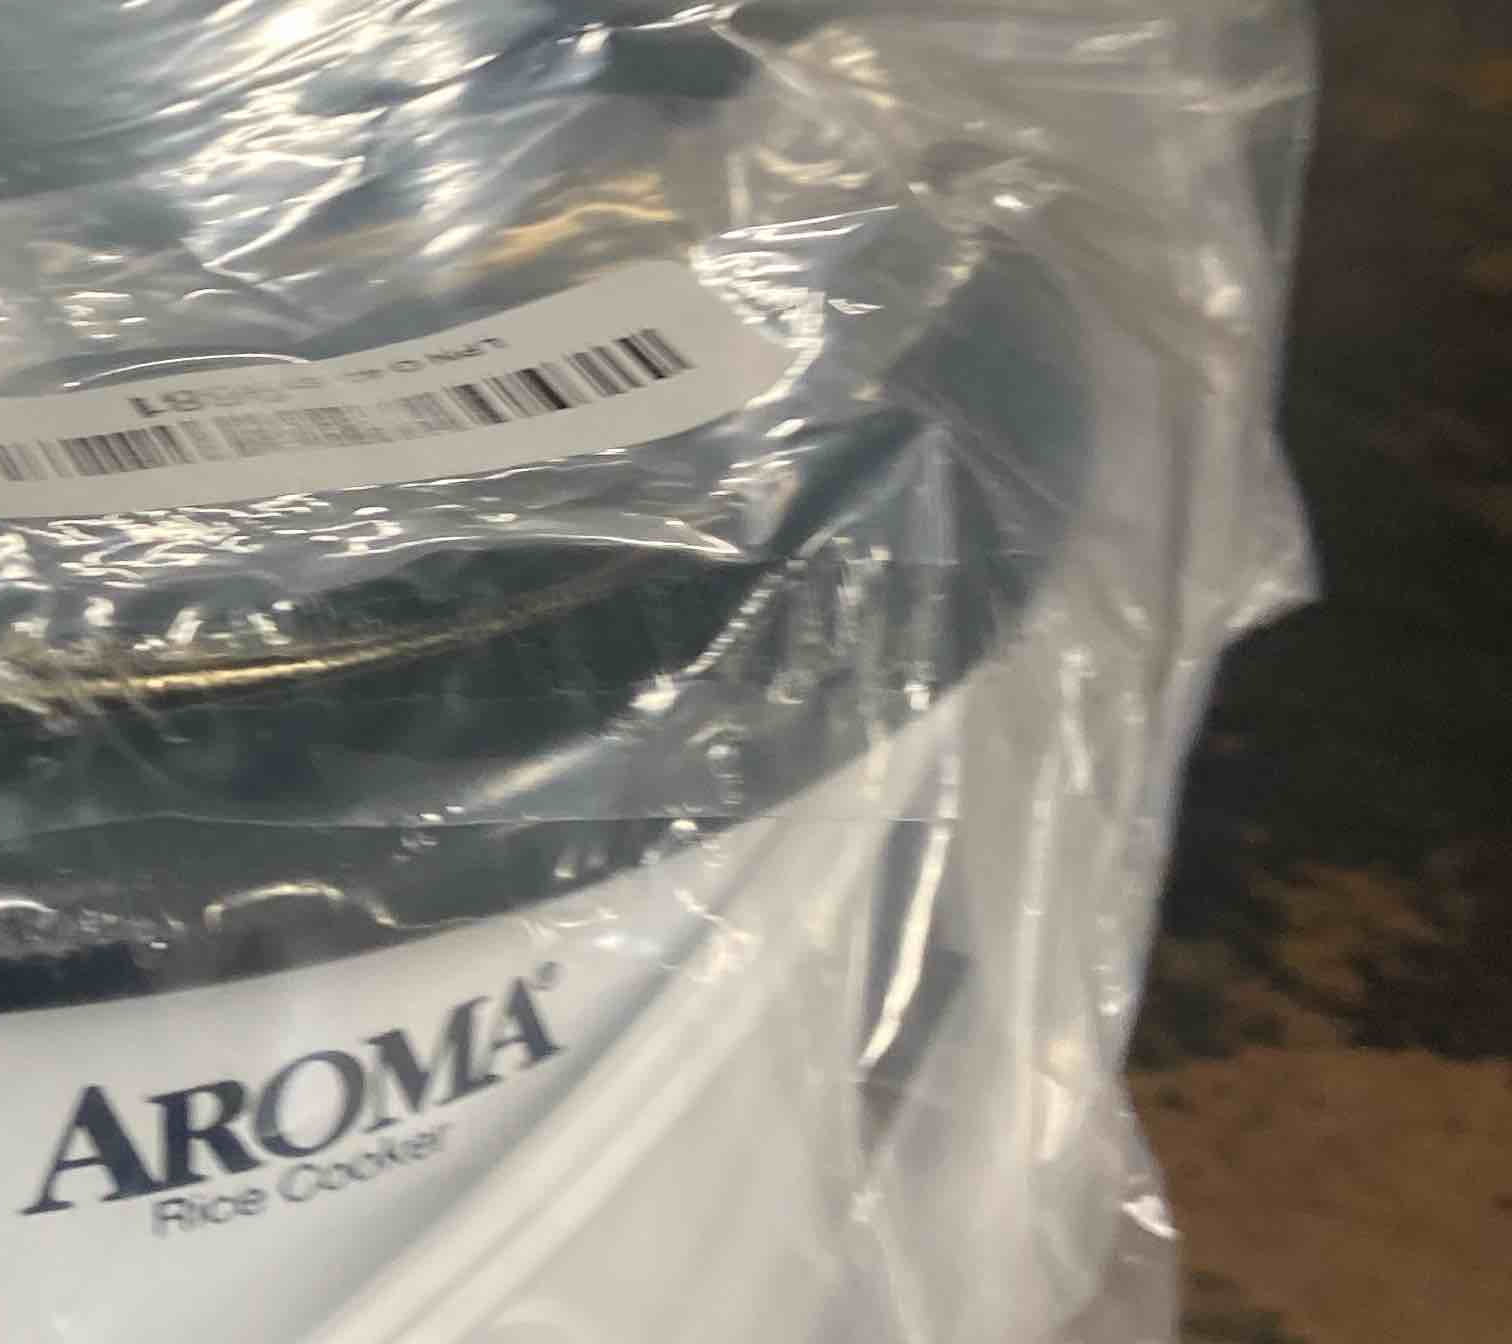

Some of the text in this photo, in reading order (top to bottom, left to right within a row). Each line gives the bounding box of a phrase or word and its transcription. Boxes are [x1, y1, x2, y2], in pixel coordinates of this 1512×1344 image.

[20, 974, 562, 1217] AROMA
[152, 1120, 452, 1240] Rice Cooker
